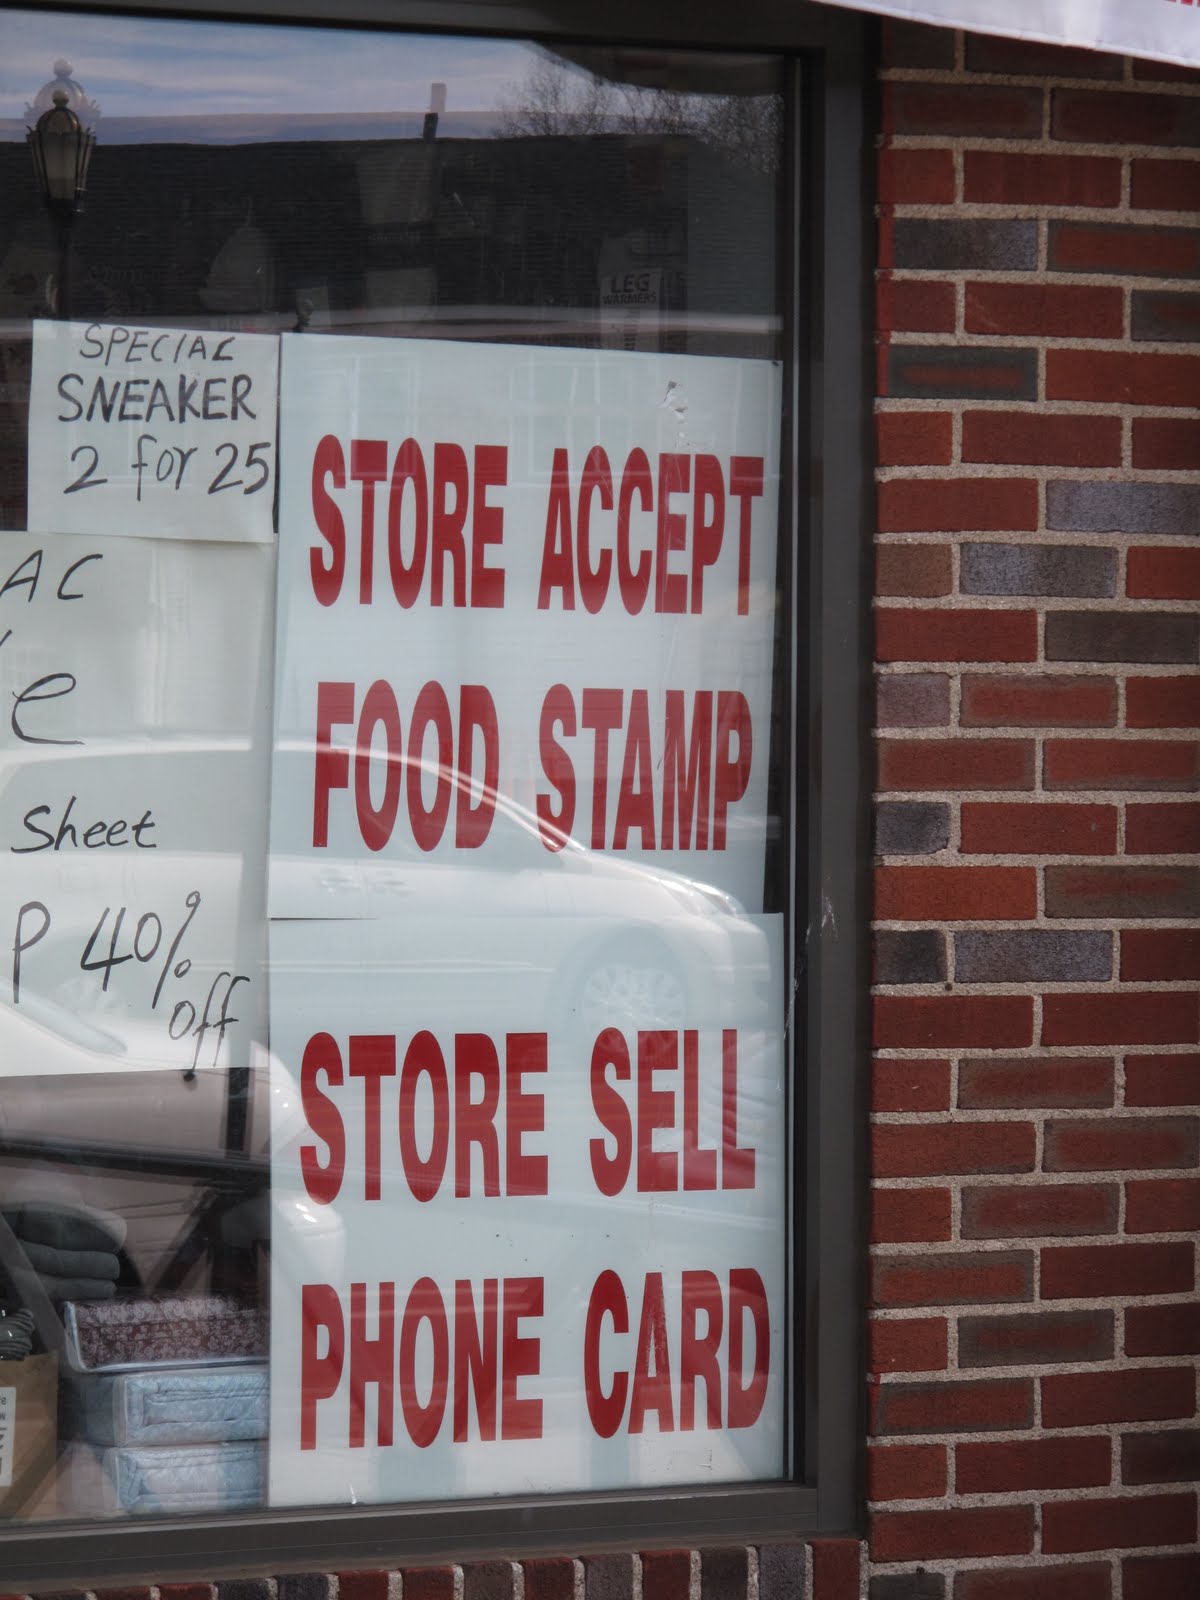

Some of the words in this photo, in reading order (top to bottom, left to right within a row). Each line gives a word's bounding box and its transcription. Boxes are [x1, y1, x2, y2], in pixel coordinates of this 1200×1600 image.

[611, 273, 651, 294] LEG
[57, 373, 257, 424] SNEAKER
[63, 445, 108, 494] 2
[131, 434, 199, 502] for
[207, 441, 272, 495] 25
[310, 434, 508, 609] STORE
[537, 445, 765, 616] ACCEPT
[312, 679, 499, 852] FOOD
[536, 683, 753, 853] STAMP
[80, 890, 201, 1009] 40%
[300, 1030, 548, 1205] STORE
[589, 1027, 756, 1197] SELL
[300, 1276, 544, 1451] PHONE
[584, 1268, 770, 1439] CARD
